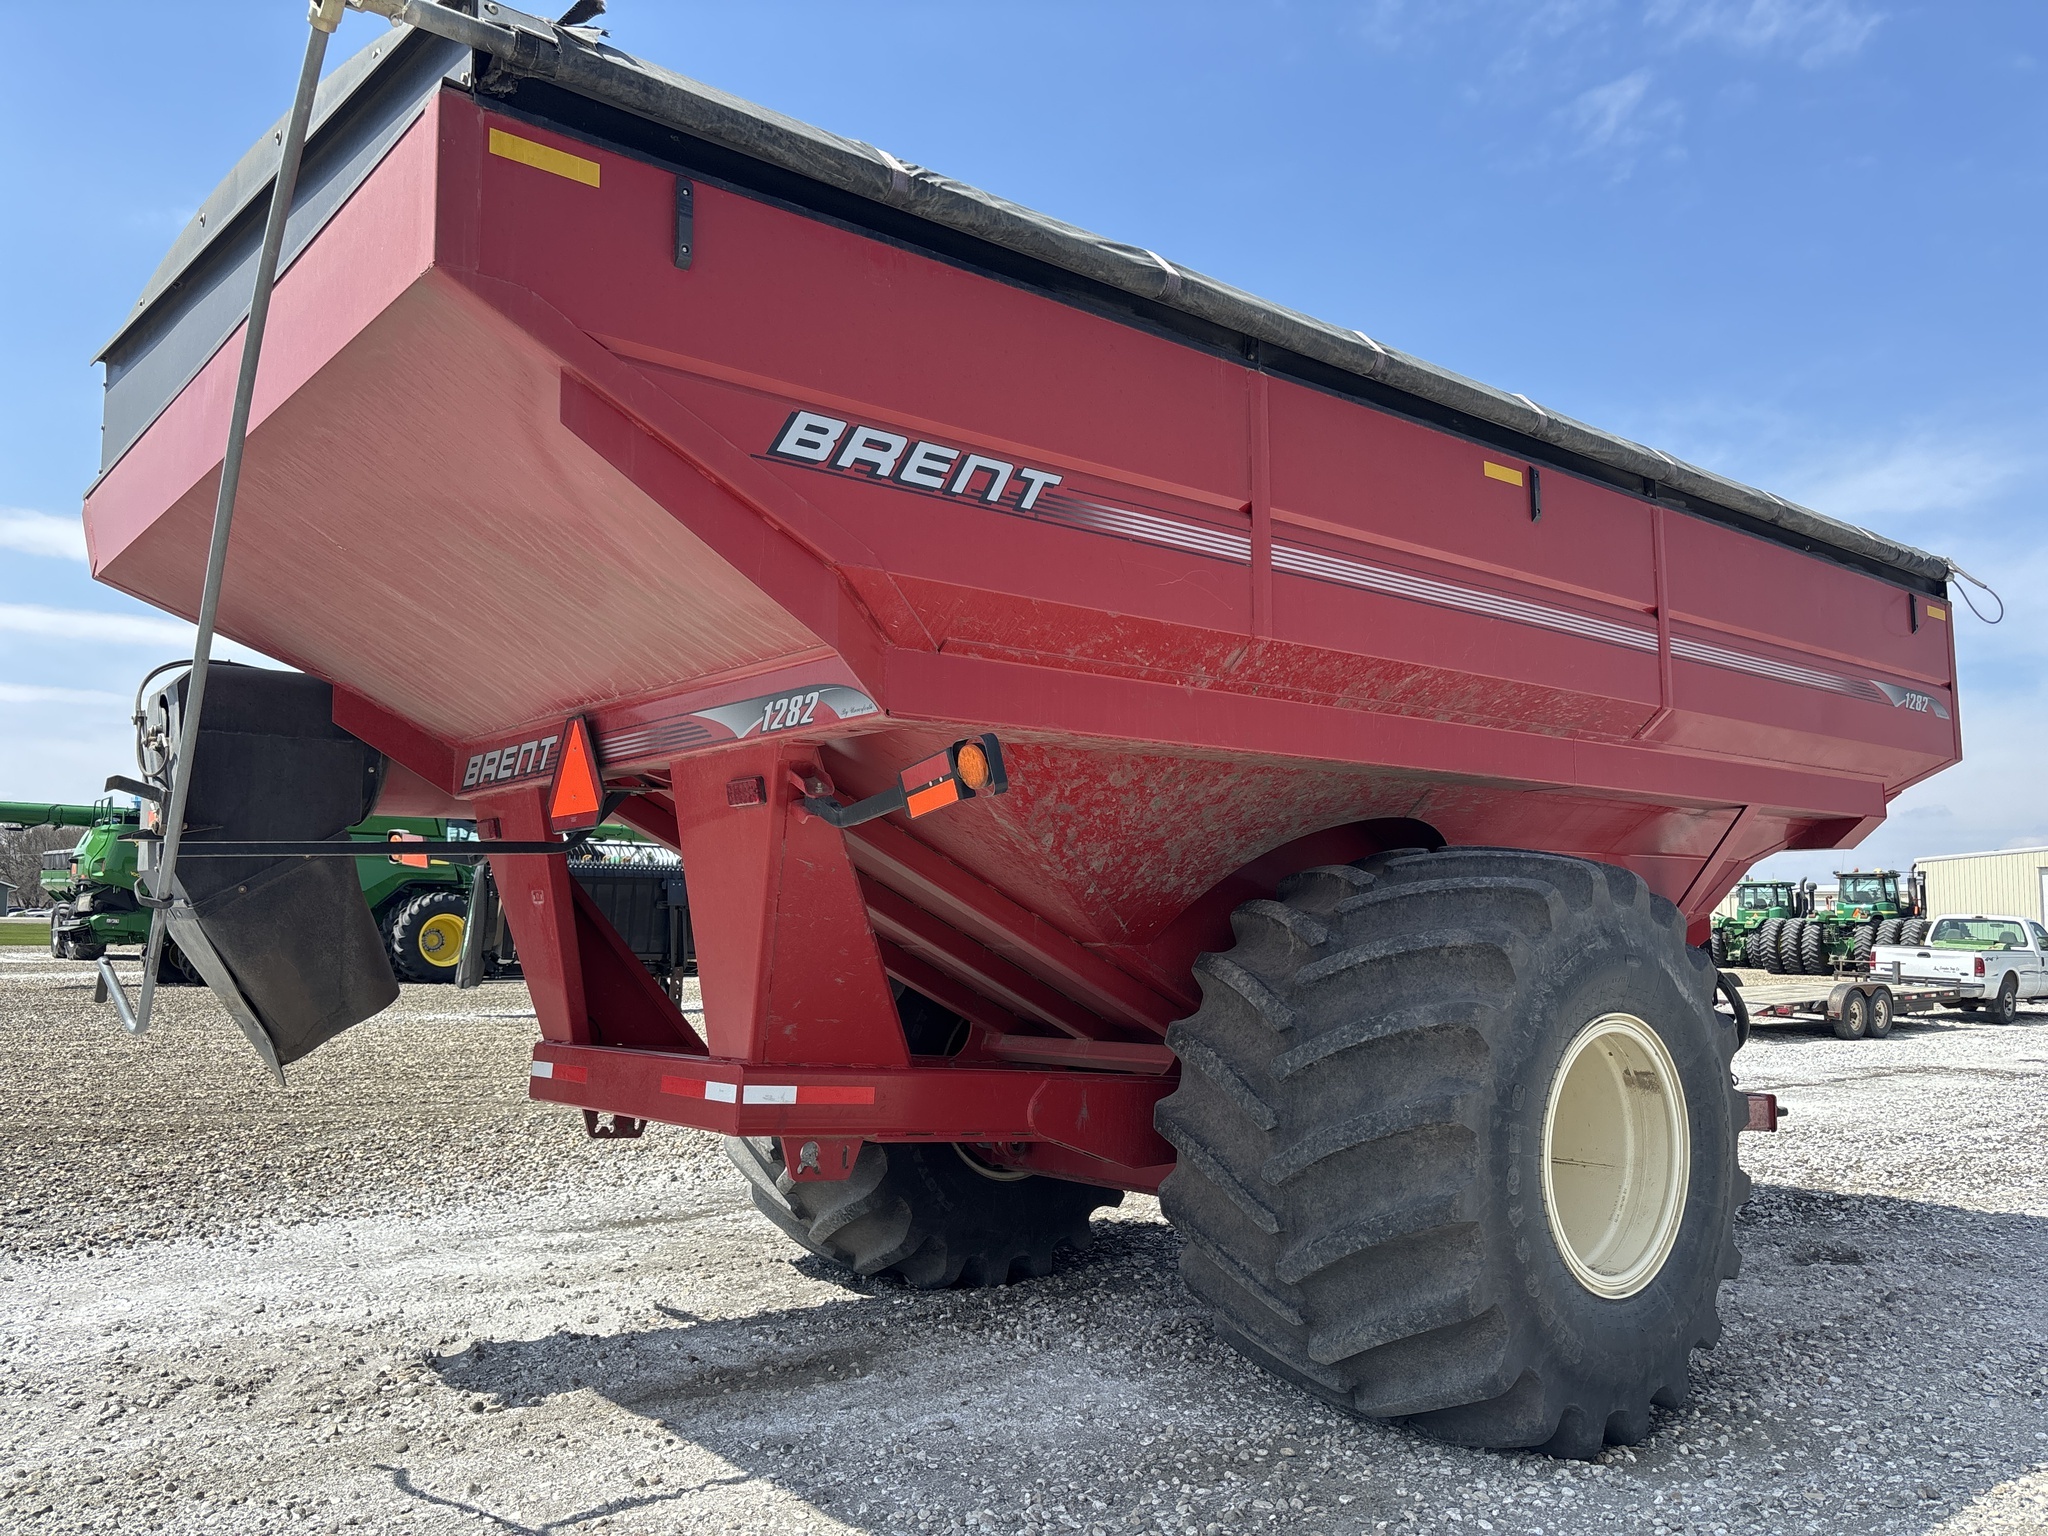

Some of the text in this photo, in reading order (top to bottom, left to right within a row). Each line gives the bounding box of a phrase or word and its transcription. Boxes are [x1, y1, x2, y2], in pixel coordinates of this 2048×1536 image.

[769, 410, 1063, 511] BRENT
[762, 691, 820, 732] 1282
[1905, 692, 1929, 713] 1282
[462, 735, 559, 789] BRENT
